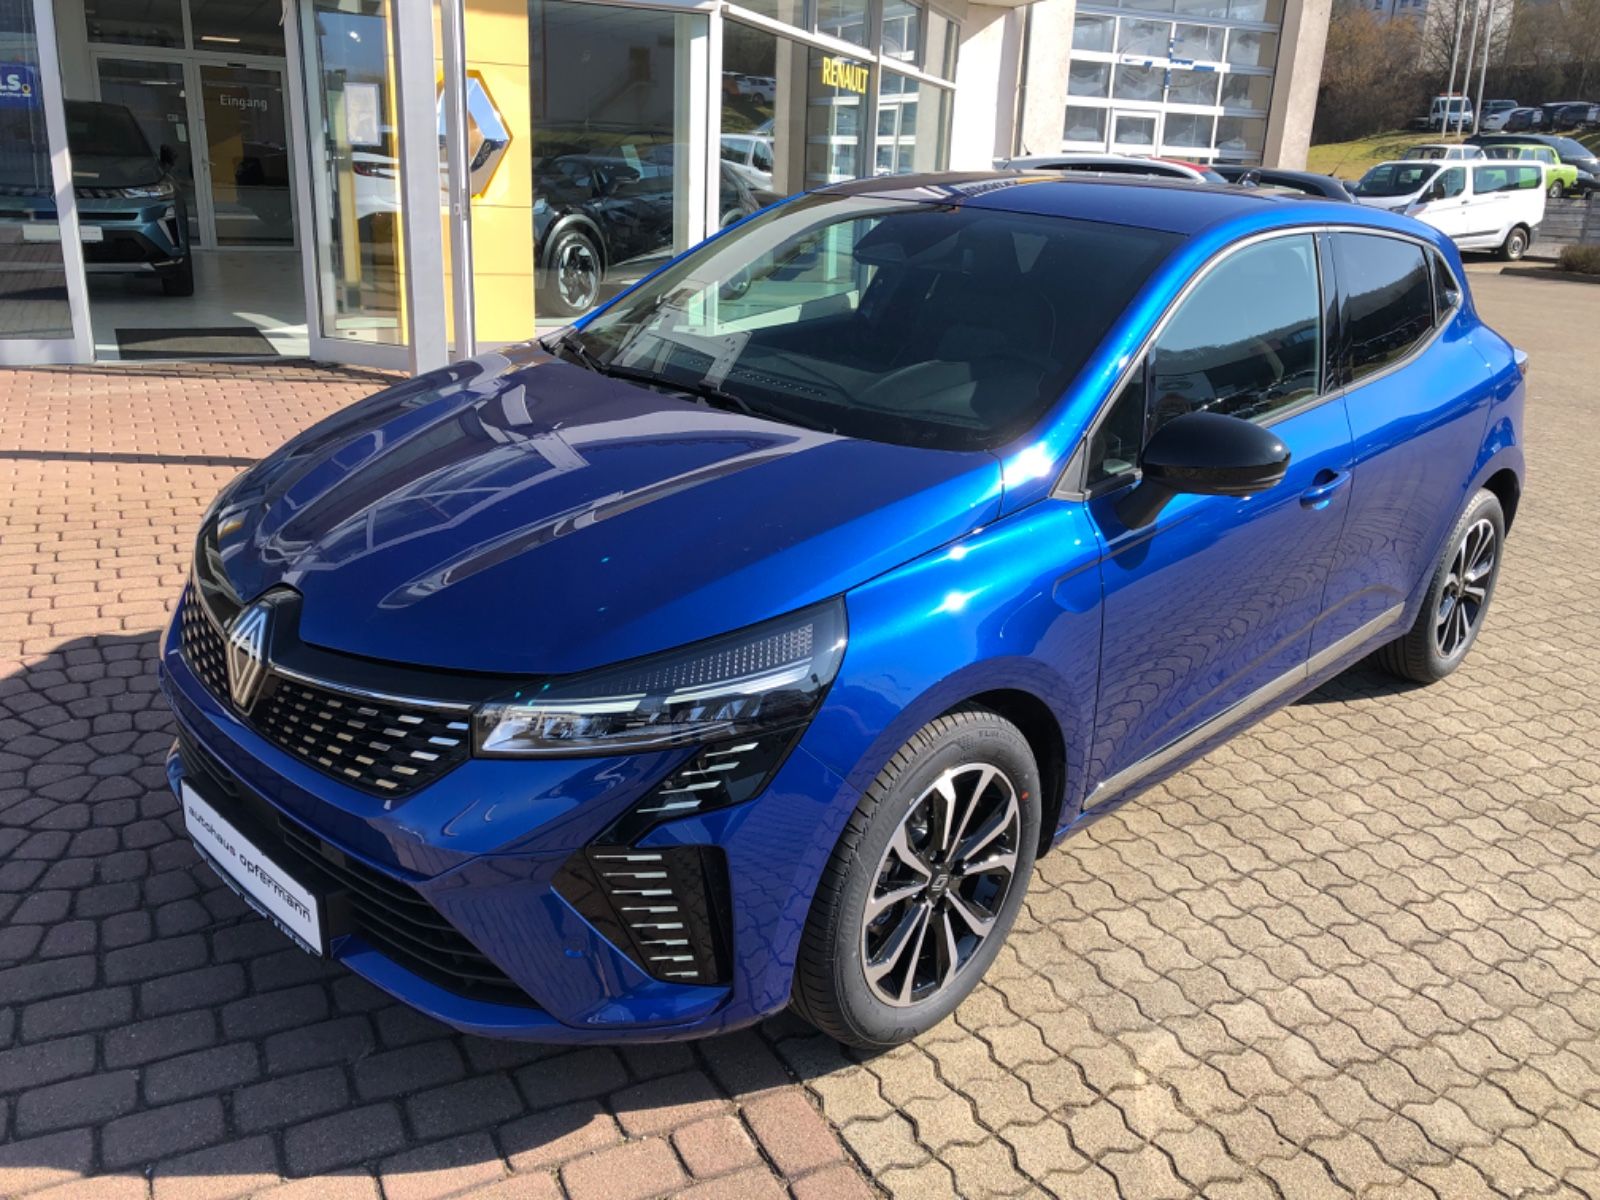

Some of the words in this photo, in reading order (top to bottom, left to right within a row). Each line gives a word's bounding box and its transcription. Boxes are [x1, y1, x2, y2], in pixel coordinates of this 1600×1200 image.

[822, 56, 868, 94] RENAULT
[220, 94, 267, 111] Eingang
[188, 805, 236, 857] autohaus
[239, 852, 312, 923] opfermann
